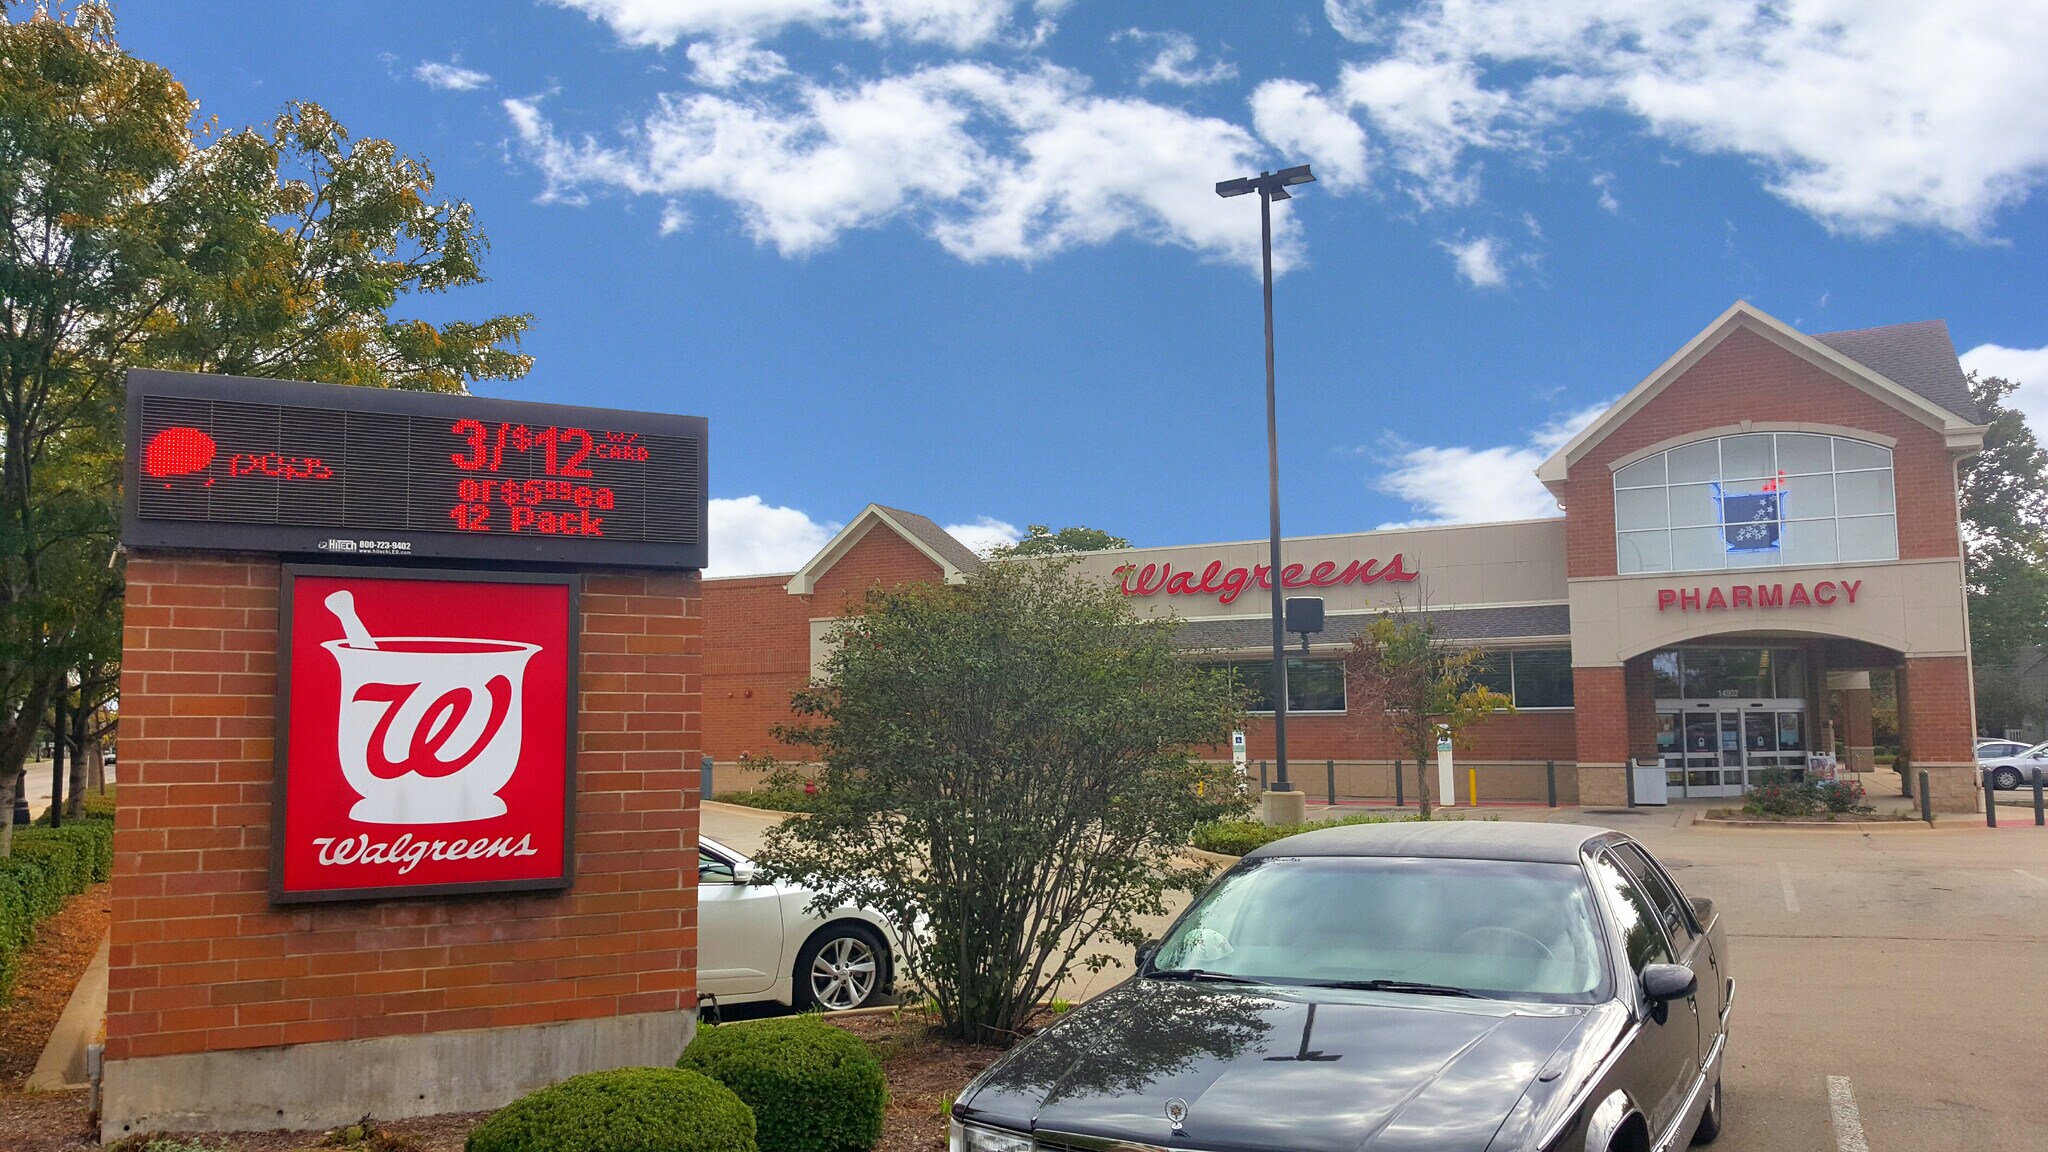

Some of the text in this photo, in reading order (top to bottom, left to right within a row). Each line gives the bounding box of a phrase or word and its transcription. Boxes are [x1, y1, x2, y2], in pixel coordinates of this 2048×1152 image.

[451, 419, 594, 477] 3/$12
[596, 443, 650, 462] CARD
[450, 503, 604, 537] 12 Pack
[359, 540, 411, 551] 800-723-9402
[1111, 553, 1419, 604] Walgreens
[1657, 579, 1863, 613] PHARMACY
[1717, 689, 1739, 698] 14902
[312, 832, 538, 876] Walgreens
